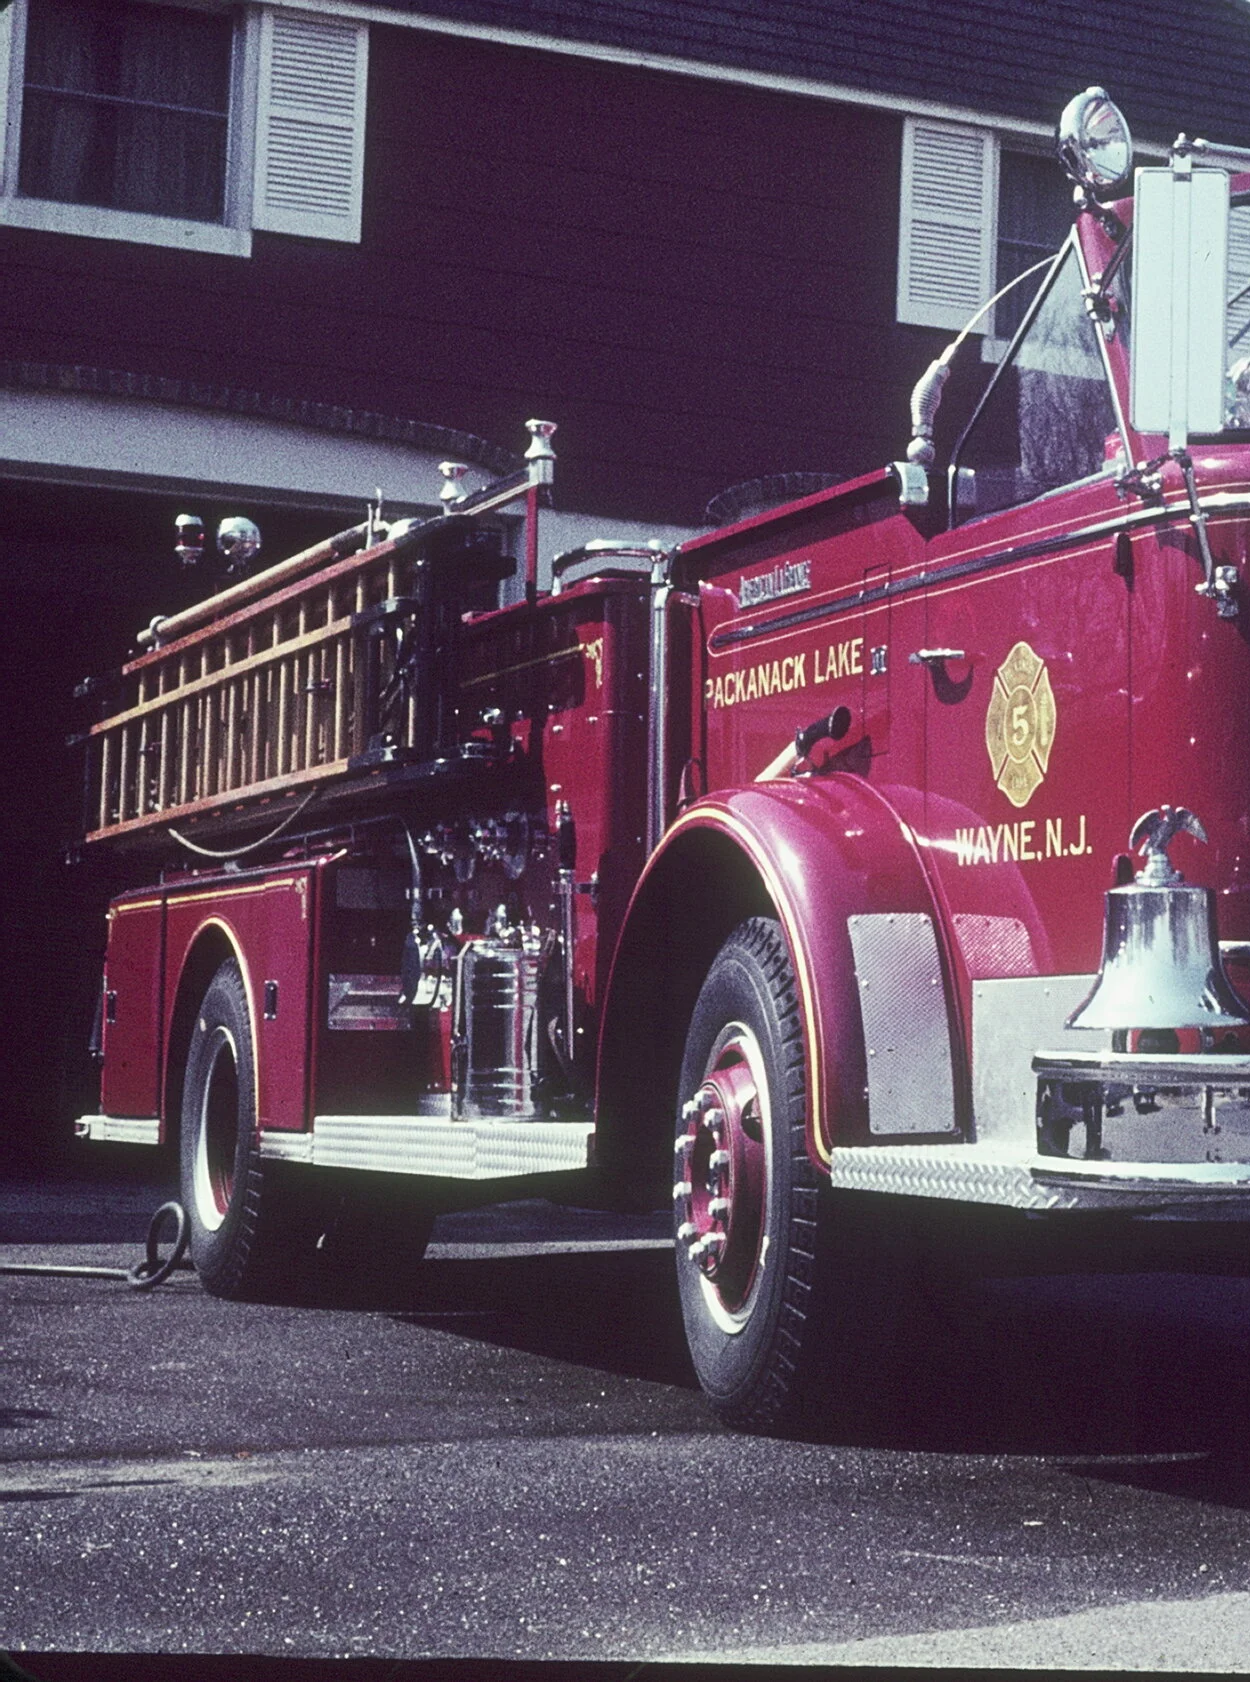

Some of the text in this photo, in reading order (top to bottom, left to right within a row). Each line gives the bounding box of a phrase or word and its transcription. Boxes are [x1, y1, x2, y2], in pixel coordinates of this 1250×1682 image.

[705, 638, 864, 709] PACKANACK LAKE
[1012, 705, 1030, 746] 5
